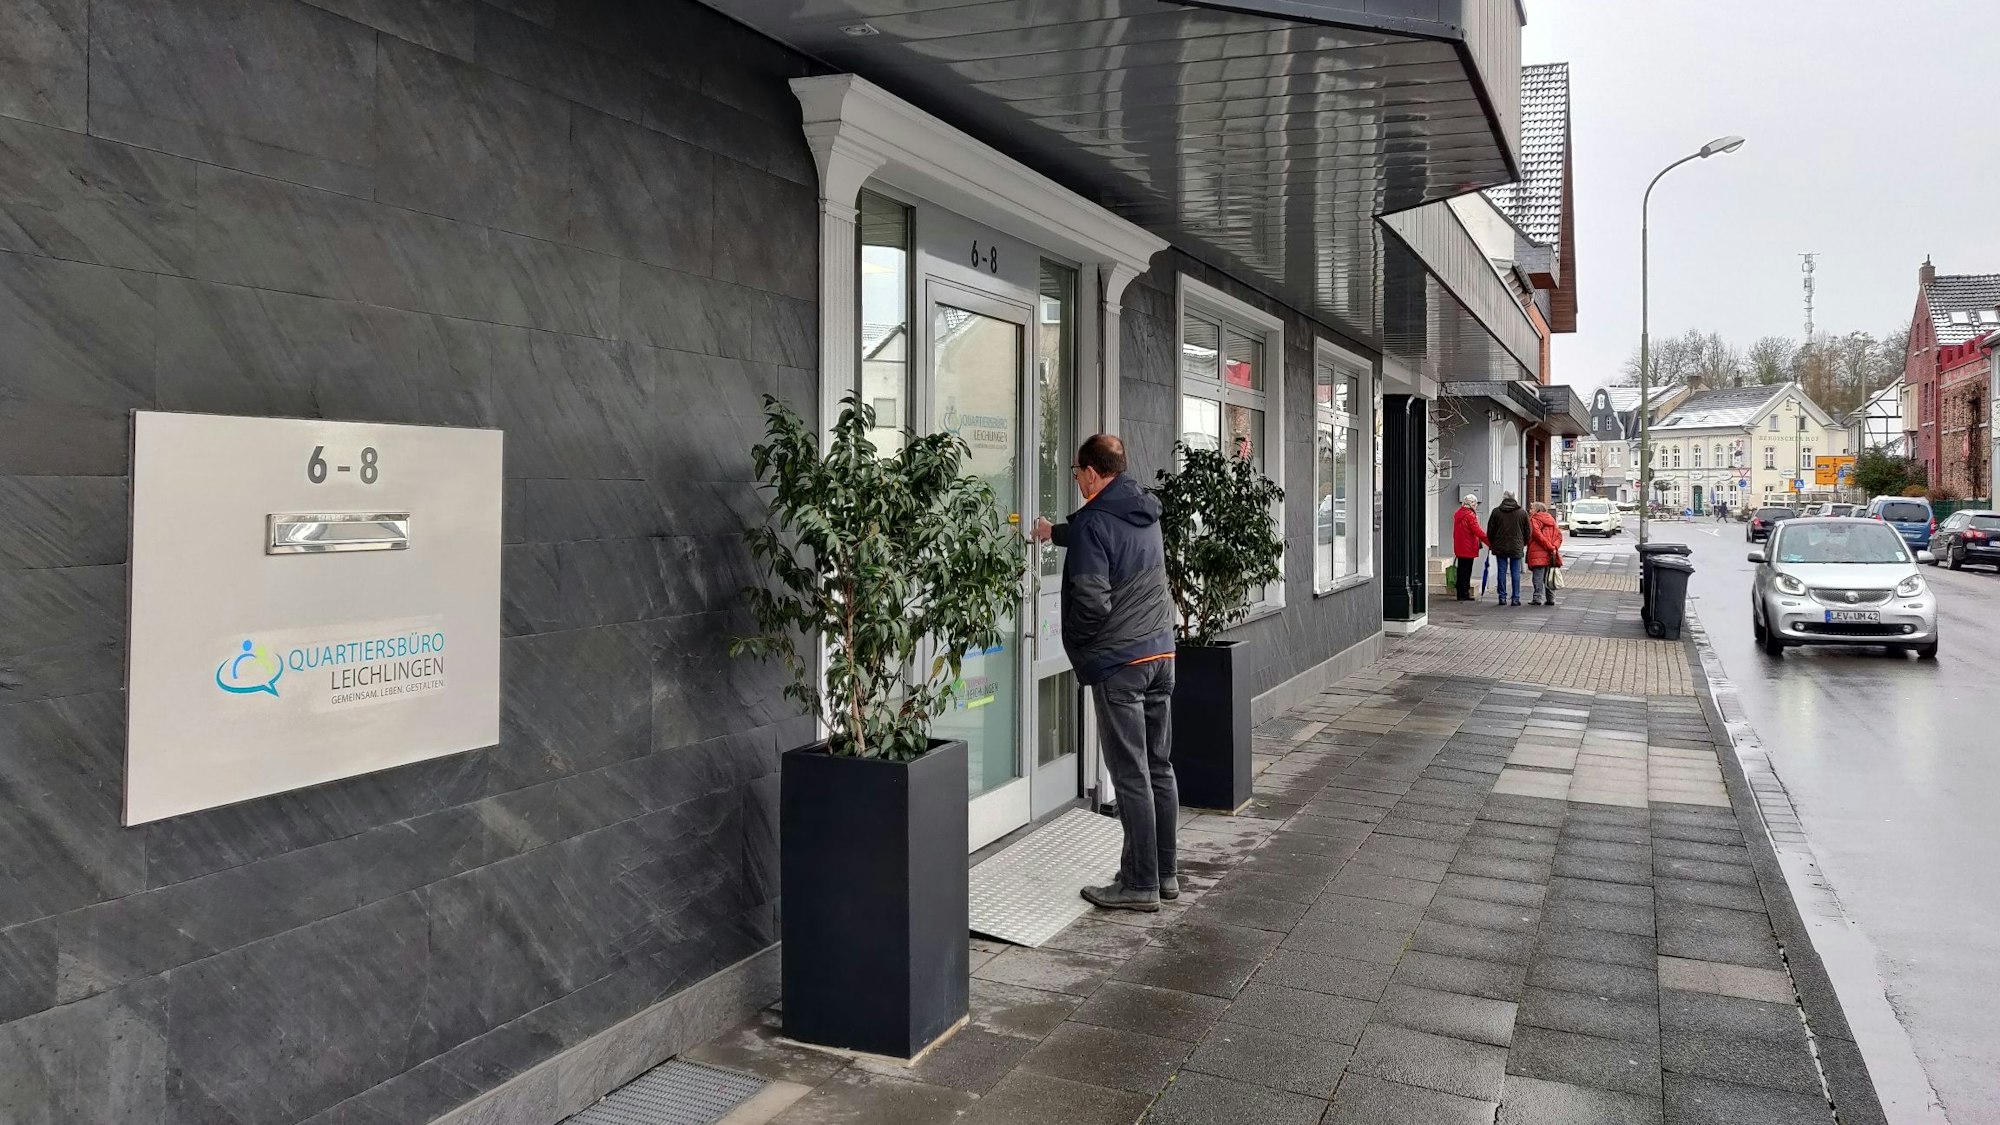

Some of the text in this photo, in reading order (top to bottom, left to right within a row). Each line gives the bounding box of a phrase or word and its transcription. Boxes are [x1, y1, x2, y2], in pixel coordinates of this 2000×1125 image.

[1831, 612, 1849, 620] LEV
[1867, 612, 1879, 621] 42
[288, 632, 445, 672] QUARTIERSBÜRO
[331, 656, 445, 691] LEICHLINGEN
[331, 680, 444, 705] GEMEINSAM. LEBEN. GESTALTEN
